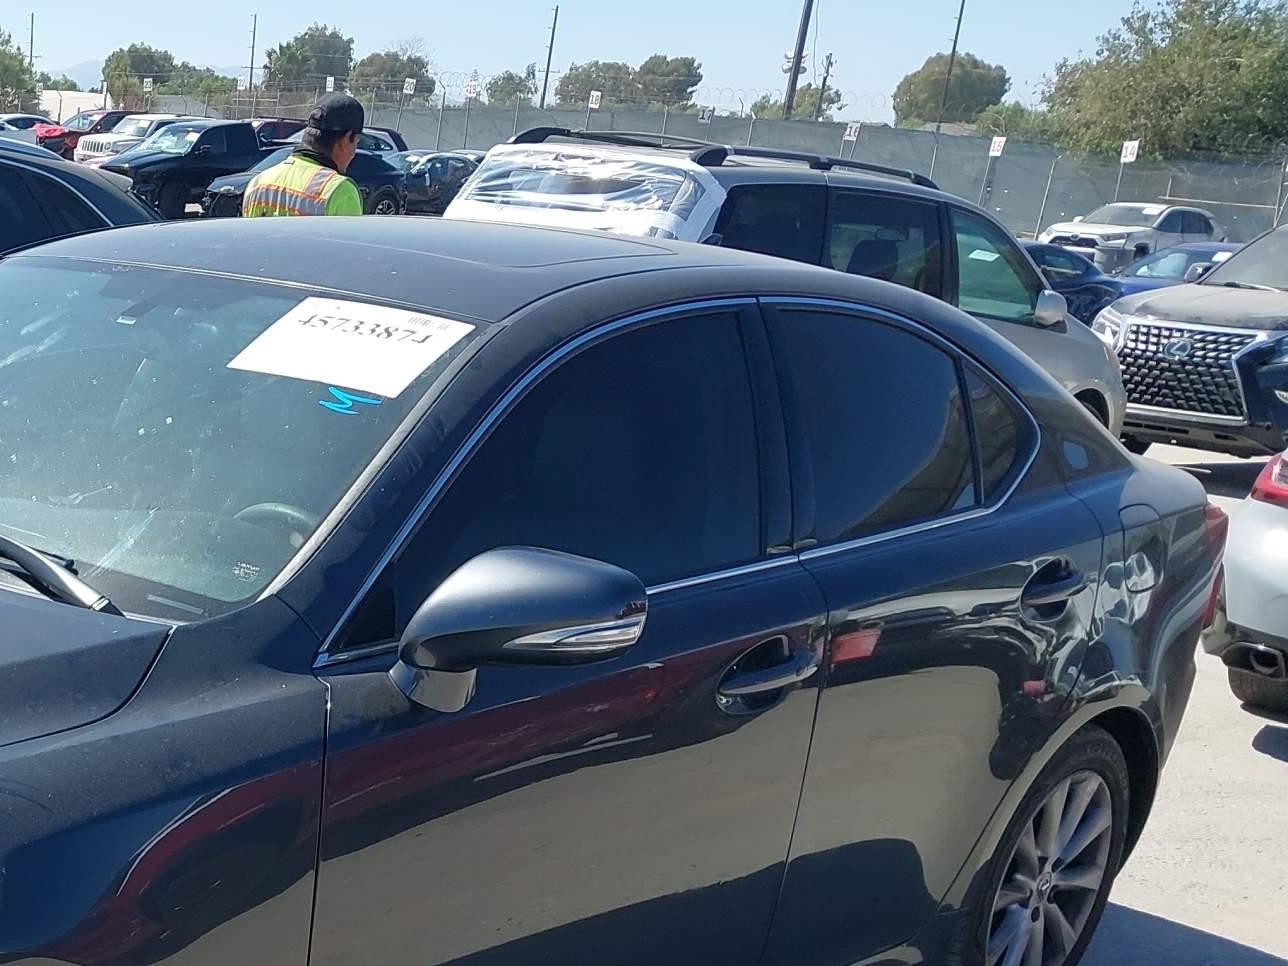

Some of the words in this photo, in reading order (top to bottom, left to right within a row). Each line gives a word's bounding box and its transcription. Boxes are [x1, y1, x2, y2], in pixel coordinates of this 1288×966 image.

[404, 81, 415, 92] 20
[590, 94, 599, 105] 18
[1122, 145, 1136, 158] 14
[298, 313, 434, 344] 45733874
